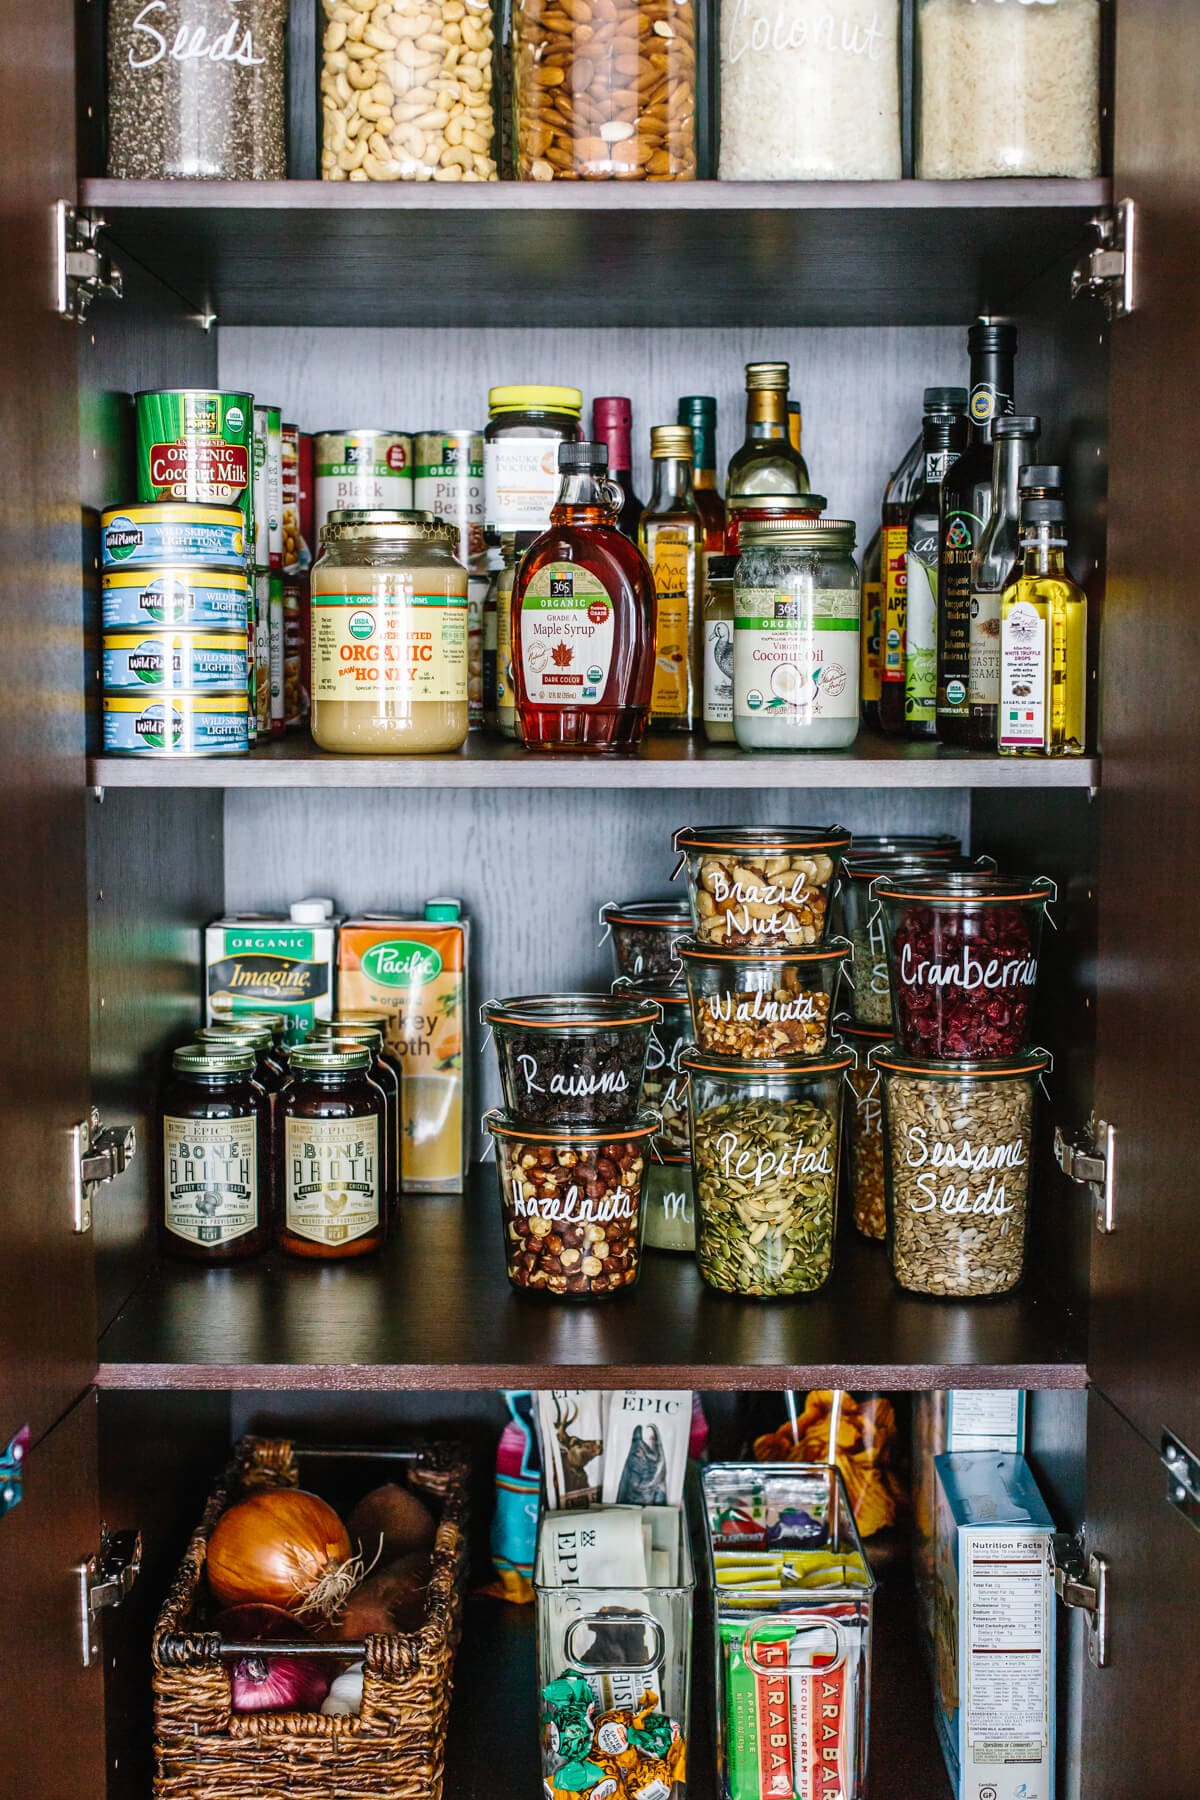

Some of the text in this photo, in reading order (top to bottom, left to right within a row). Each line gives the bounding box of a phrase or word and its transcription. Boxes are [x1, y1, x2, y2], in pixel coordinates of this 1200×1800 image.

[128, 0, 266, 68] Seeds
[217, 463, 246, 482] Milk
[332, 466, 387, 475] ORGAIC
[430, 466, 484, 475] ORGAIC
[496, 465, 538, 473] DOCTOR
[436, 482, 479, 498] Pino
[184, 527, 226, 538] SKIPJACK
[197, 537, 222, 547] TUNA
[654, 562, 687, 577] Mac
[553, 581, 570, 594] 365
[656, 577, 685, 590] Nut
[540, 599, 586, 608] ORGANIC
[777, 604, 797, 615] 365
[547, 613, 578, 622] GRADE A
[533, 623, 595, 638] Maple Syrup
[338, 665, 355, 678] RAW
[544, 676, 580, 684] DARK COLOR
[707, 871, 810, 904] Brazil
[725, 904, 803, 937] Nuts
[231, 938, 305, 948] ORGANIC
[369, 947, 434, 978] Pacific
[227, 962, 311, 997] Imagine
[380, 995, 422, 1006] organc
[709, 990, 818, 1022] Walnuts
[516, 1053, 630, 1097] Raisins
[193, 1127, 221, 1136] EPIC
[178, 1142, 240, 1159] BONE
[716, 1132, 834, 1187] Pepitas
[511, 1179, 637, 1223] Hazelnuts
[911, 1172, 1016, 1217] Seeds
[621, 1396, 681, 1416] EPIC
[746, 1691, 757, 1753] APPLE PIE
[820, 1680, 840, 1800] ÄRABAR
[982, 1791, 993, 1799] GF
